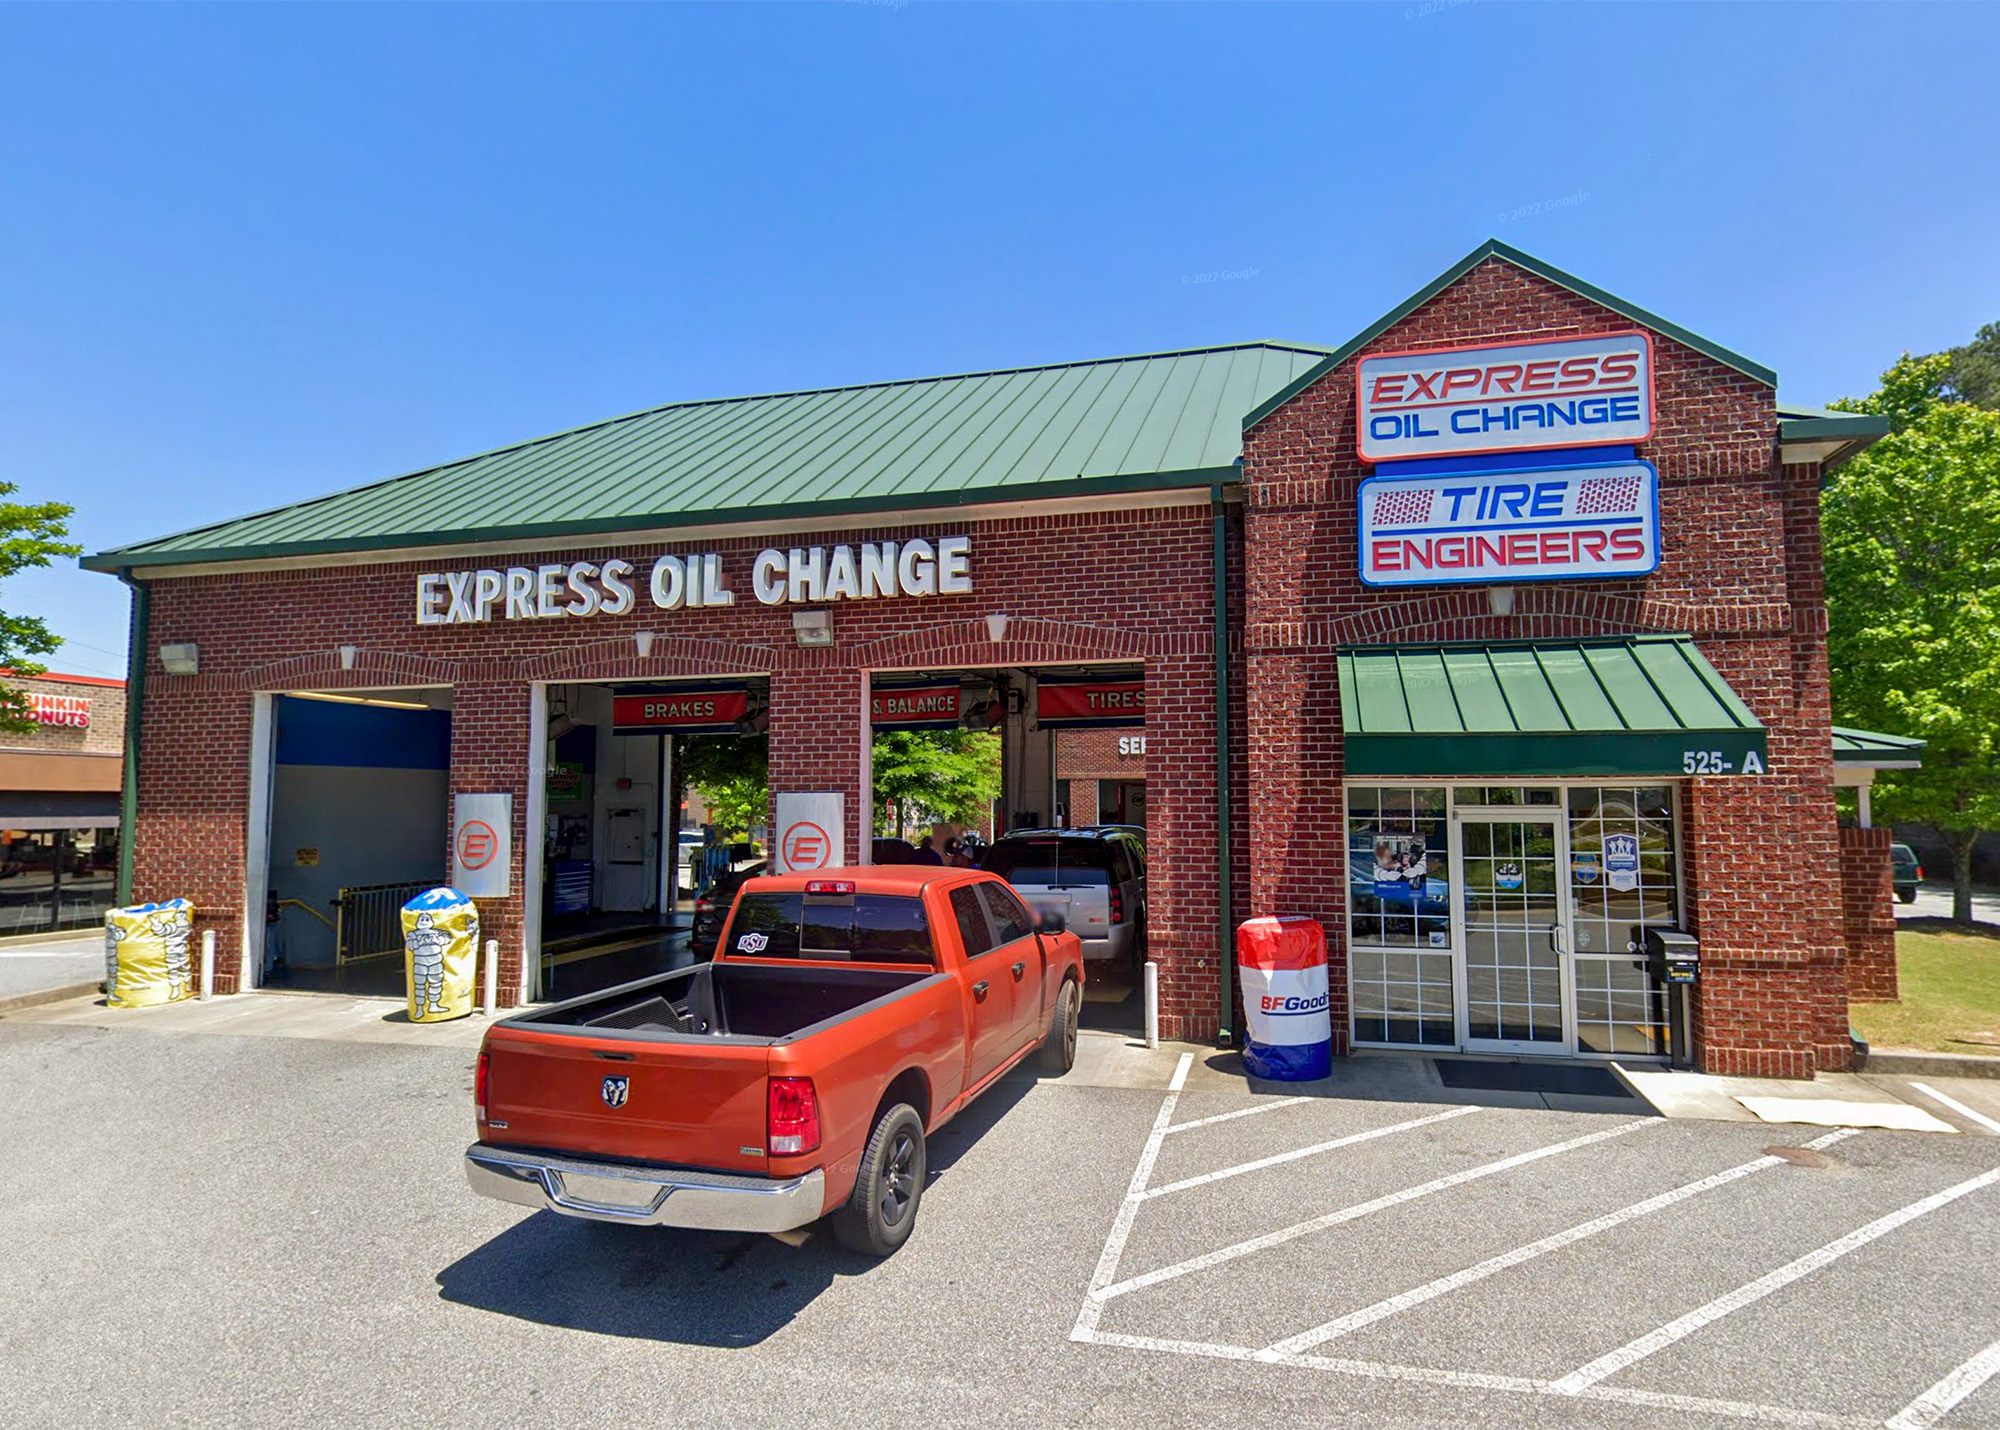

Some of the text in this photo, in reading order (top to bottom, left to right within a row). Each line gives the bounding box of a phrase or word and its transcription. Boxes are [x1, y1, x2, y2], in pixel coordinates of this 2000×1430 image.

[1370, 353, 1640, 404] EXPRESS
[1370, 395, 1640, 440] OIL CHANGE
[1442, 481, 1569, 521] TIRE
[1372, 528, 1645, 571] ENGINEERS
[417, 536, 973, 625] EXPRESS OIL CHANGE
[25, 694, 93, 712] UNKIN'
[644, 701, 715, 718] BRAKES
[873, 695, 955, 714] & BALANCE
[1087, 690, 1145, 709] TIRES
[24, 710, 89, 726] ONUTS
[1683, 750, 1764, 774] 525- A
[463, 834, 490, 858] E
[791, 837, 823, 863] E
[740, 934, 766, 951] OSU
